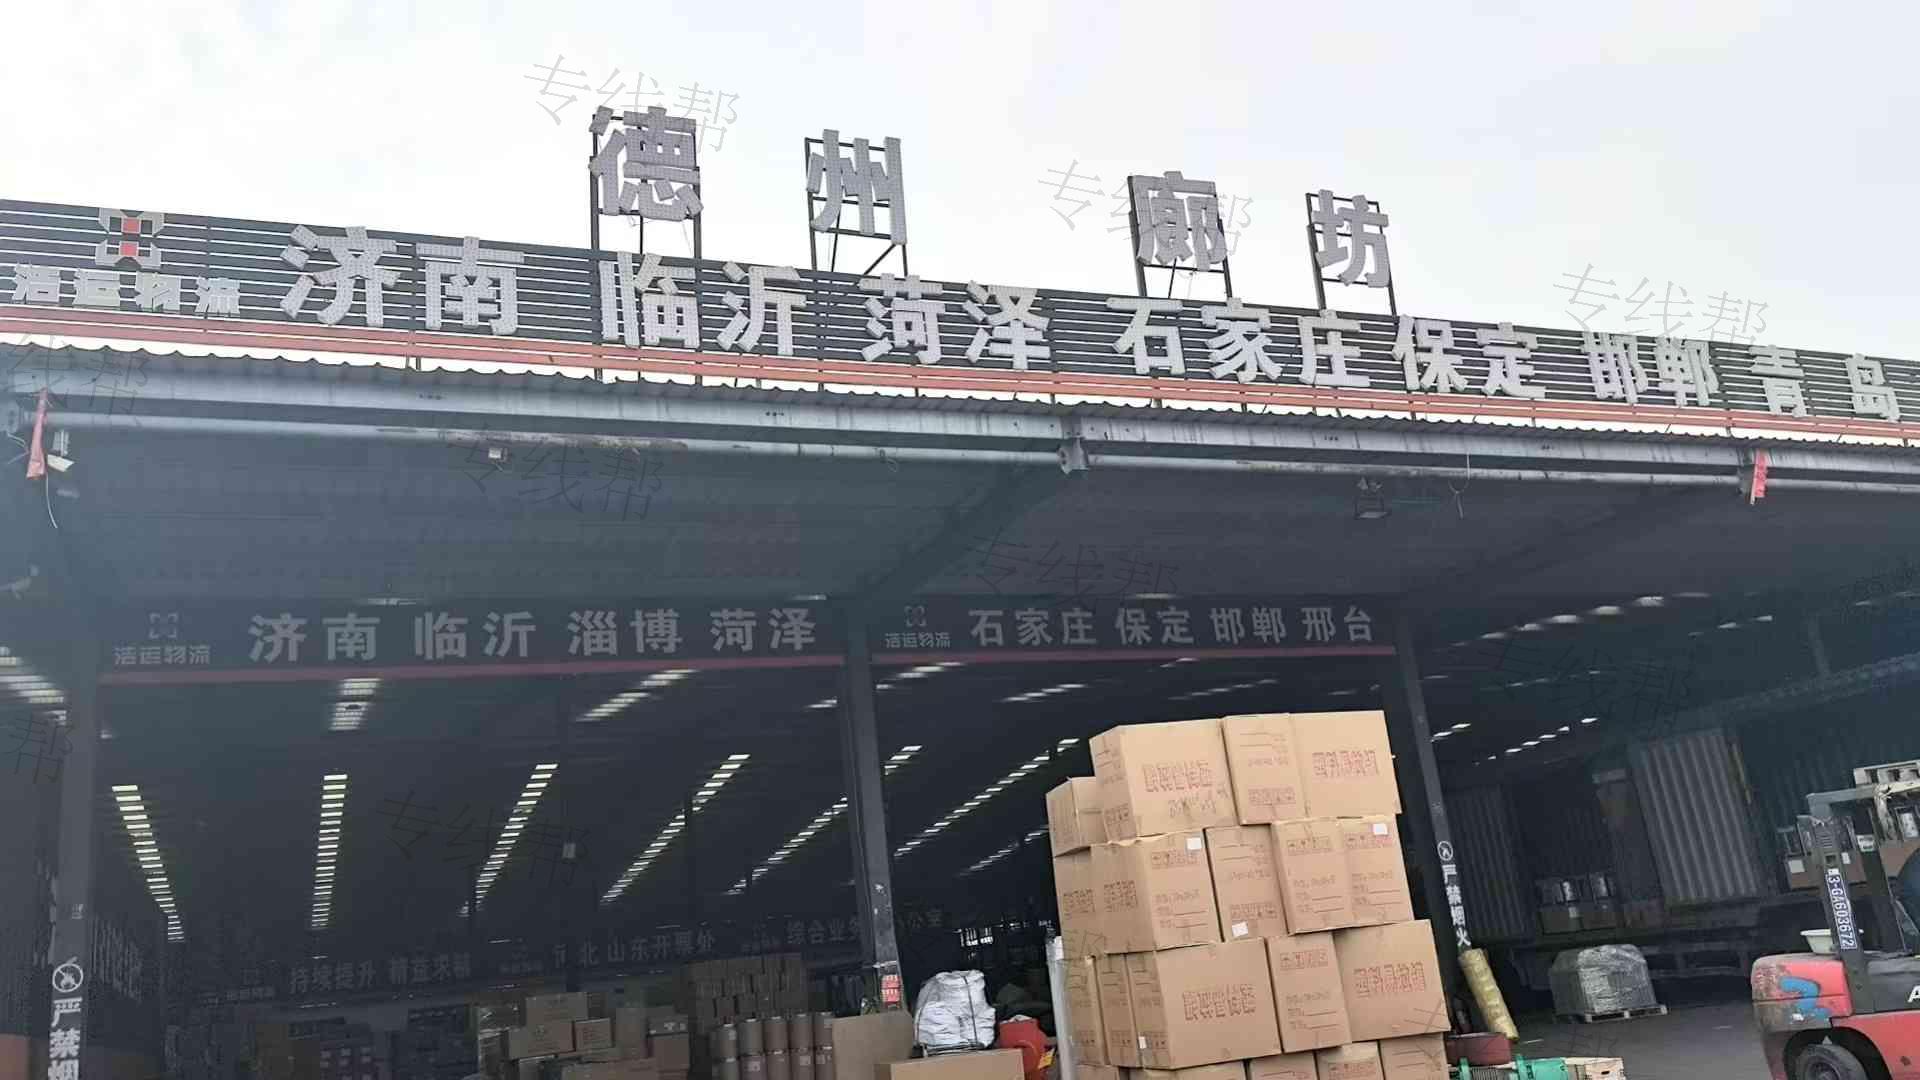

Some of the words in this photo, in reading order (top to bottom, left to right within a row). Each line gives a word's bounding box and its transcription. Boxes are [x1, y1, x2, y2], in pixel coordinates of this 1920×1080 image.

[589, 106, 907, 245] 德州
[1133, 171, 1391, 287] 廊坊
[280, 224, 525, 336] 济南
[599, 251, 808, 357] 临沂
[859, 272, 1052, 371] 菏泽
[1107, 296, 1371, 390] 石家庄
[1390, 314, 1545, 397] 保定
[1581, 331, 1721, 408] 邯郸
[1748, 344, 1902, 421] 青岛
[249, 611, 381, 665] 济南
[415, 609, 538, 661] 临沂
[567, 608, 683, 657] 淄博
[709, 607, 818, 653] 菏泽
[967, 607, 1098, 648] 石家庄
[1116, 605, 1195, 645] 保定
[1209, 605, 1286, 645] 邯郸
[1302, 604, 1374, 643] 邢台
